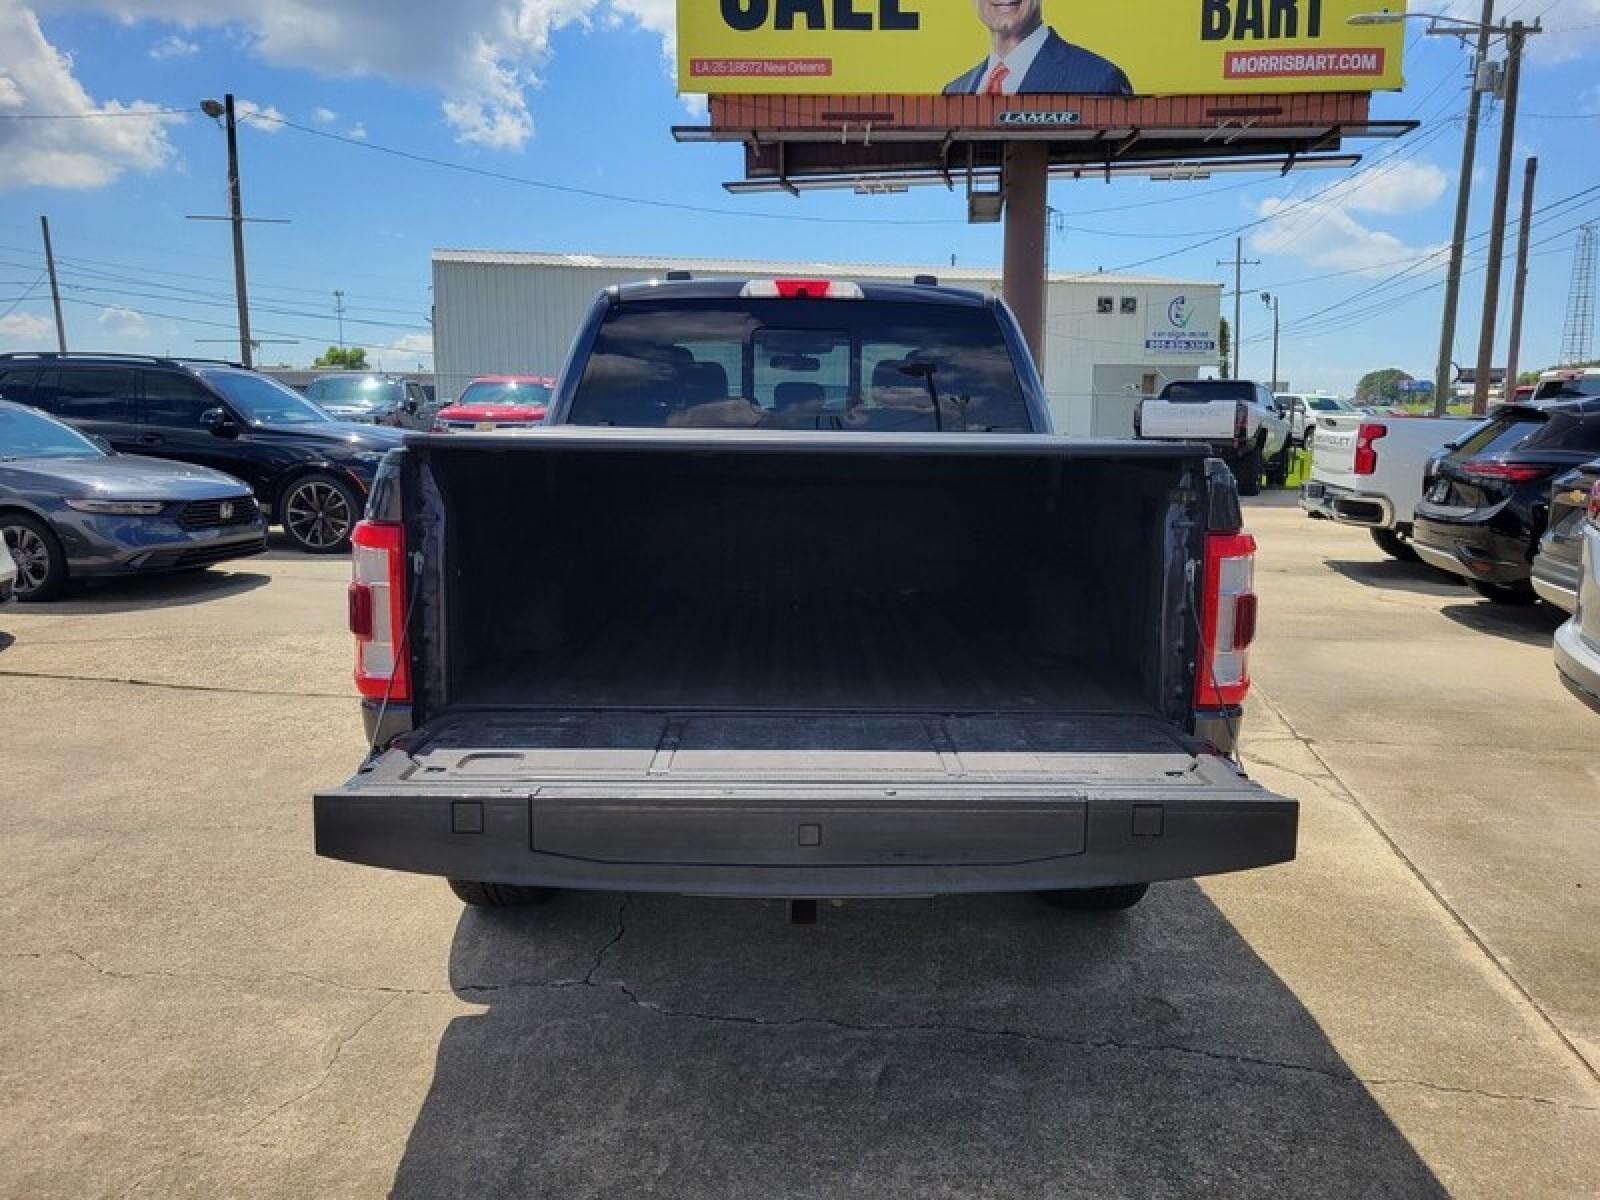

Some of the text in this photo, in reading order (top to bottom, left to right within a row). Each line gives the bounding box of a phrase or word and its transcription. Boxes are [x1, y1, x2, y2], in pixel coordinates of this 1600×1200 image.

[764, 61, 787, 73] New
[788, 61, 827, 73] Orleans
[1231, 54, 1377, 73] MORRISBART.COM
[1004, 112, 1073, 123] LAMAR
